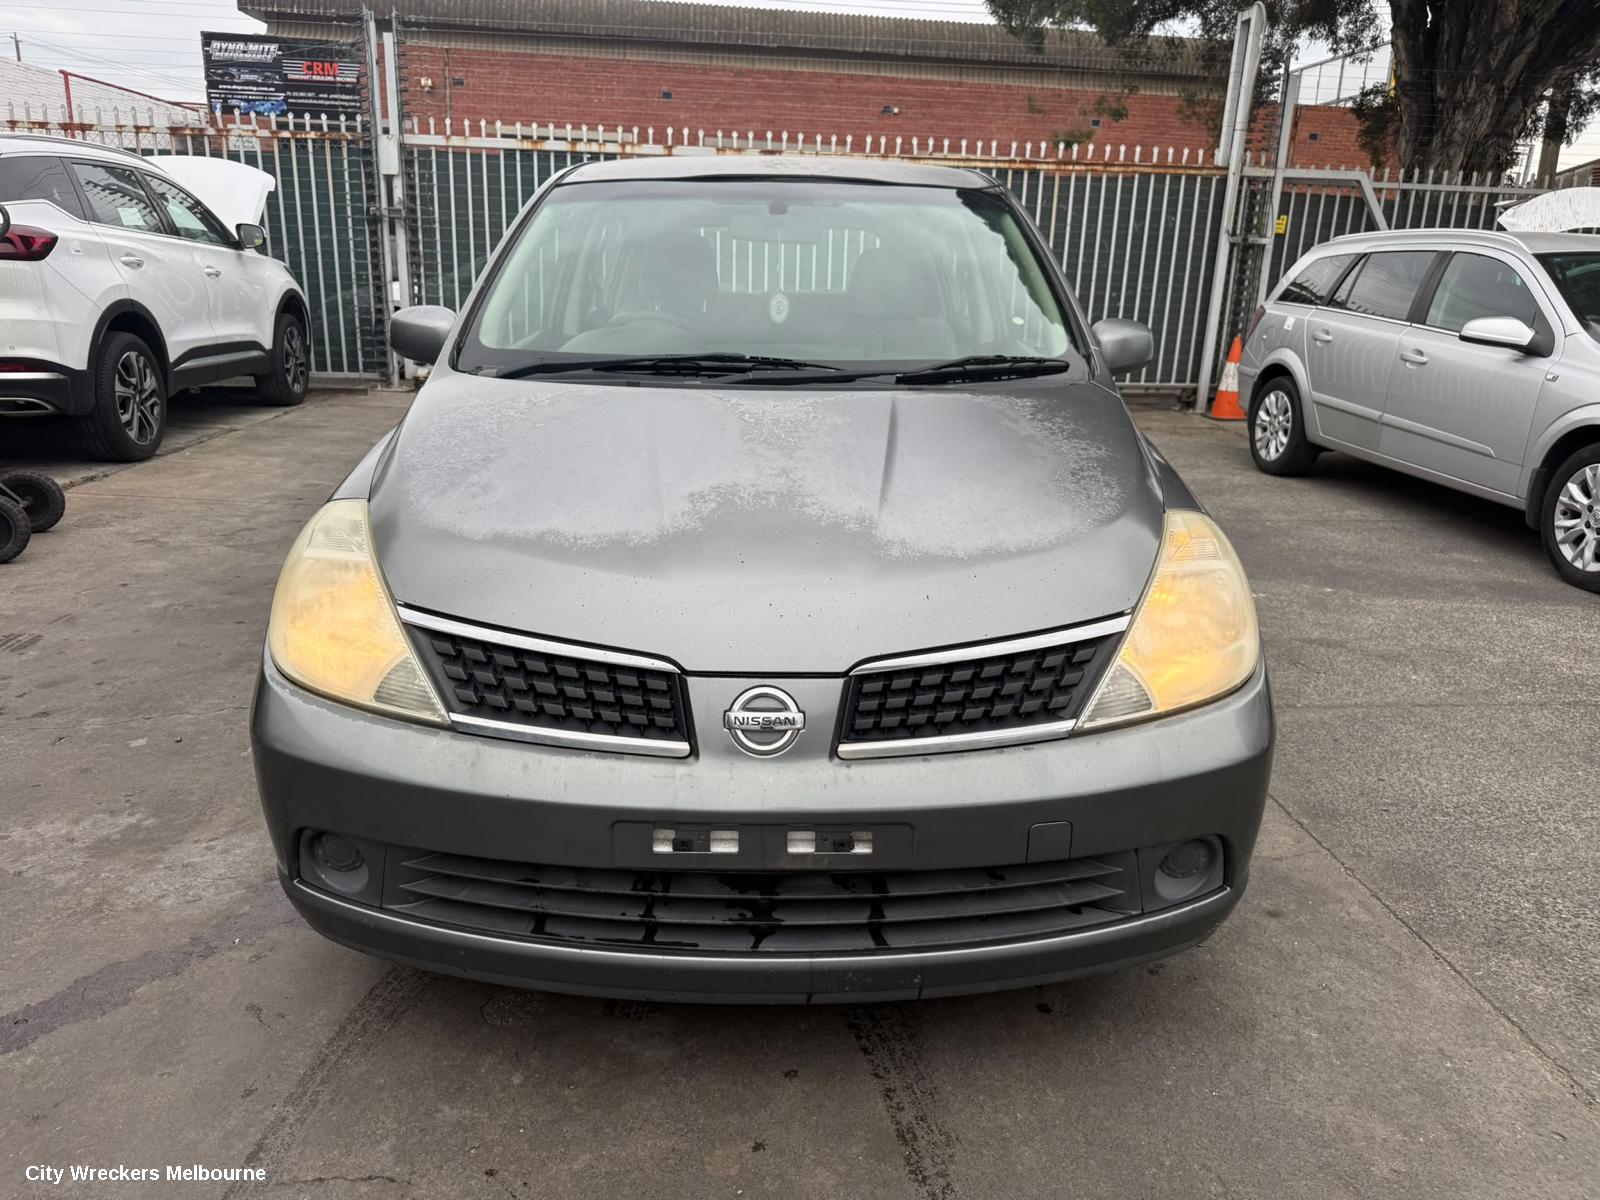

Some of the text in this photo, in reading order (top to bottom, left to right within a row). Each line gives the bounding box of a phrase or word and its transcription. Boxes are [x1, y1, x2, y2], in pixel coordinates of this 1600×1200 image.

[210, 41, 278, 56] DYNO-MITE
[212, 51, 274, 61] PERFORMANCE
[303, 61, 339, 76] CRM
[733, 716, 796, 726] NISSAN
